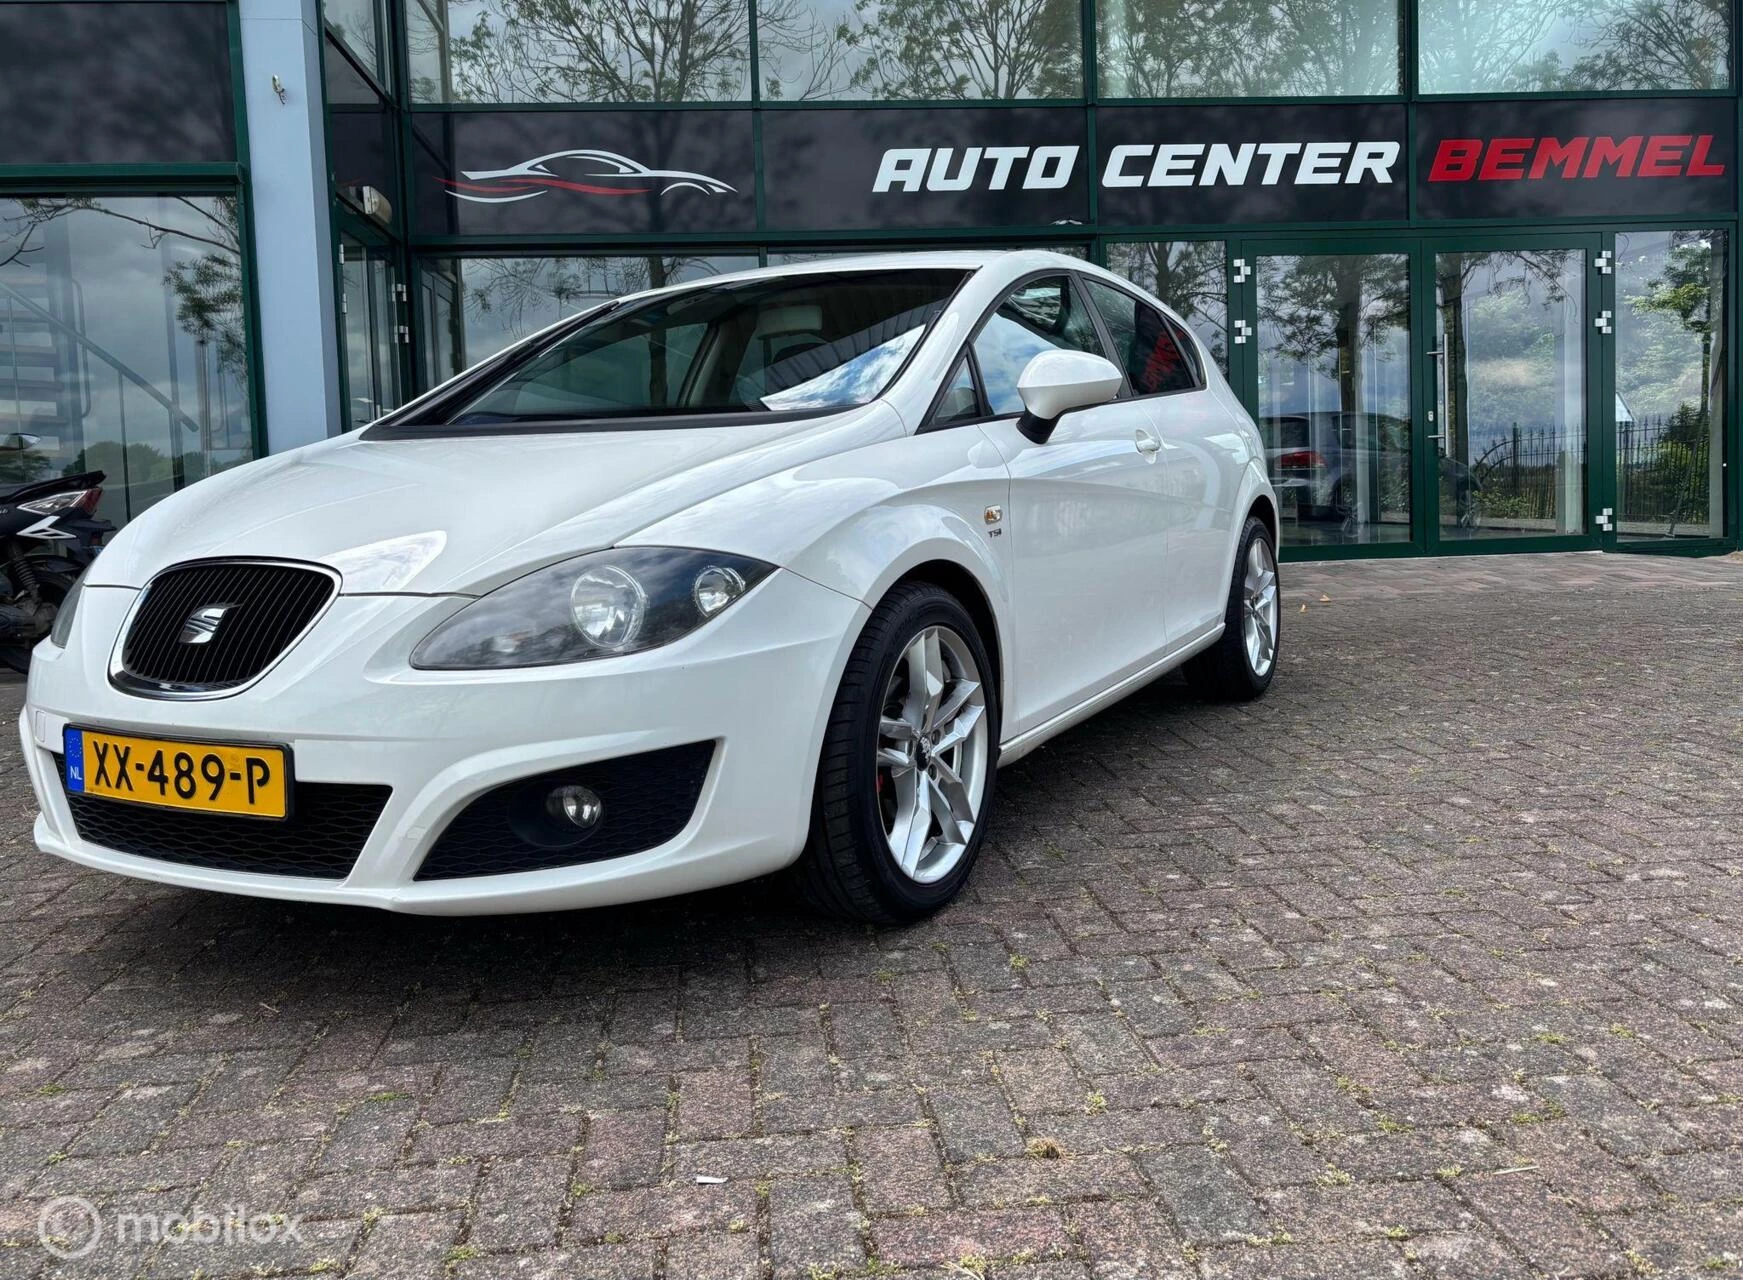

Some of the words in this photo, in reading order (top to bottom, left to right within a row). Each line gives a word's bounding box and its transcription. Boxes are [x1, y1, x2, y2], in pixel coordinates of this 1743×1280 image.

[872, 145, 1080, 192] AUTO
[1101, 141, 1401, 188] CENTER
[1428, 135, 1726, 182] BEMMEL
[70, 765, 83, 780] NL
[93, 740, 270, 805] XX-489-P
